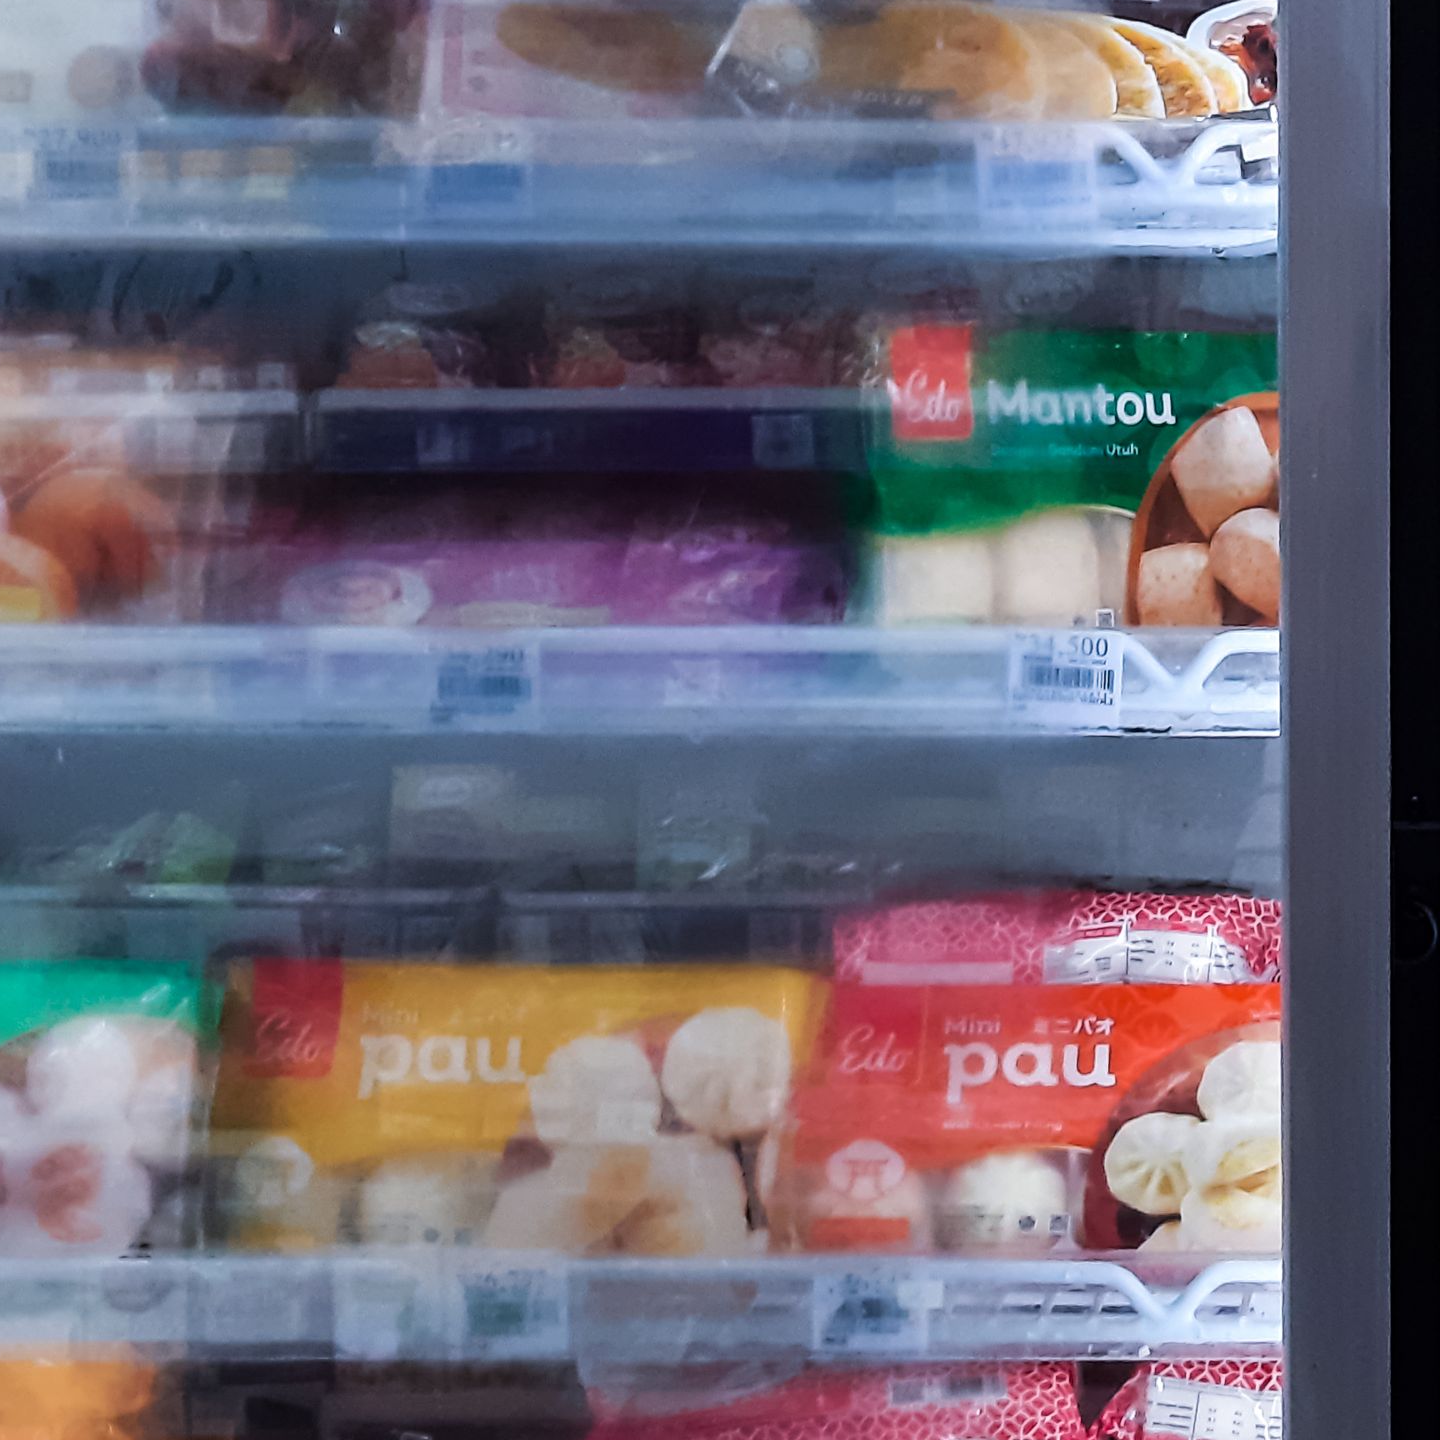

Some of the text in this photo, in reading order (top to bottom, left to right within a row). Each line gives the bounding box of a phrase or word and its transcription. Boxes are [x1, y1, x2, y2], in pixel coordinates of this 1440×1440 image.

[986, 378, 1178, 426] Mantou
[1105, 443, 1140, 457] Utuh
[359, 1033, 526, 1101] pau
[942, 1040, 1117, 1106] pau
